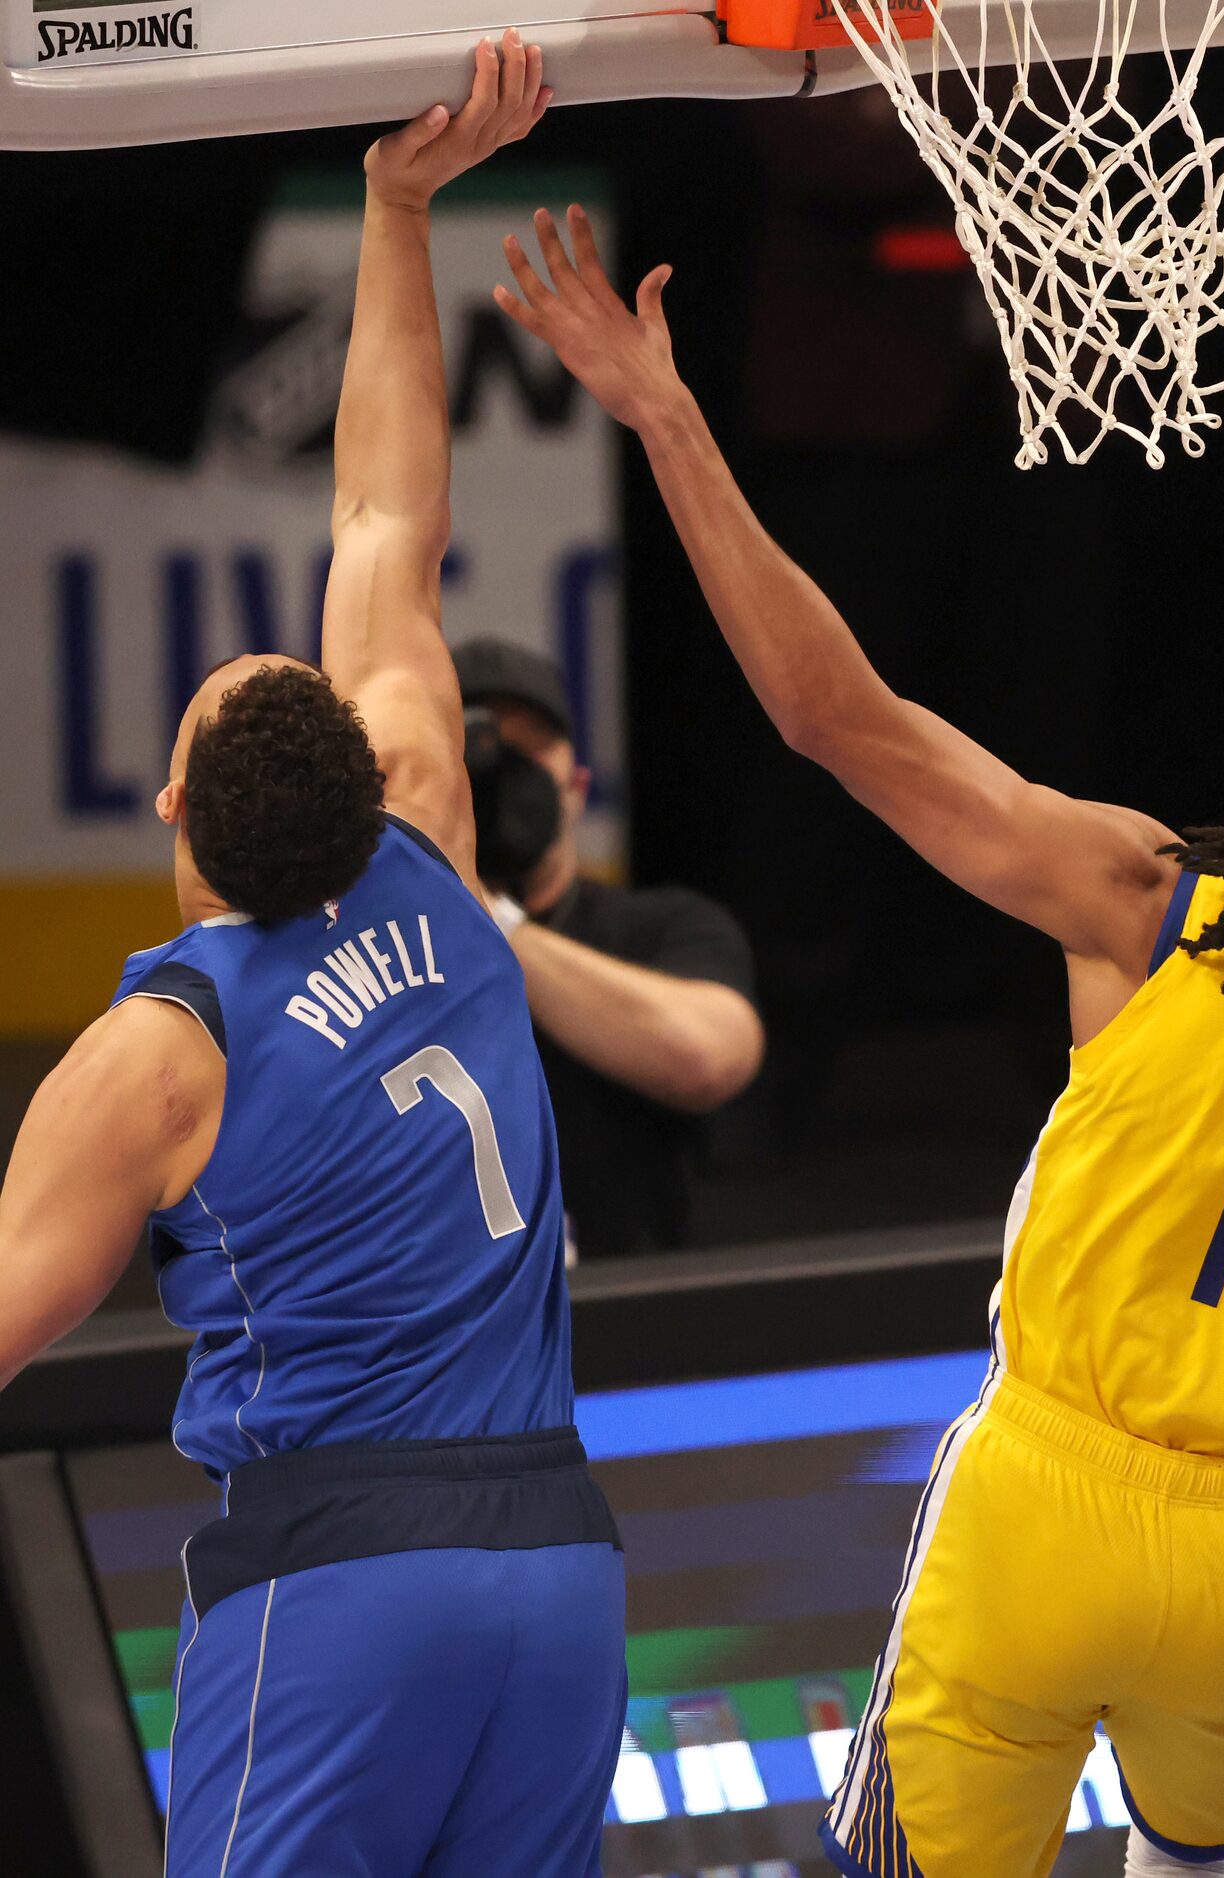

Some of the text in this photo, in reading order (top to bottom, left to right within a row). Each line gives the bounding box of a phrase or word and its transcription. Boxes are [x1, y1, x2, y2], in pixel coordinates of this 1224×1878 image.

[37, 7, 193, 62] SPALDING
[284, 914, 446, 1050] POWELL
[379, 1044, 527, 1240] 7
